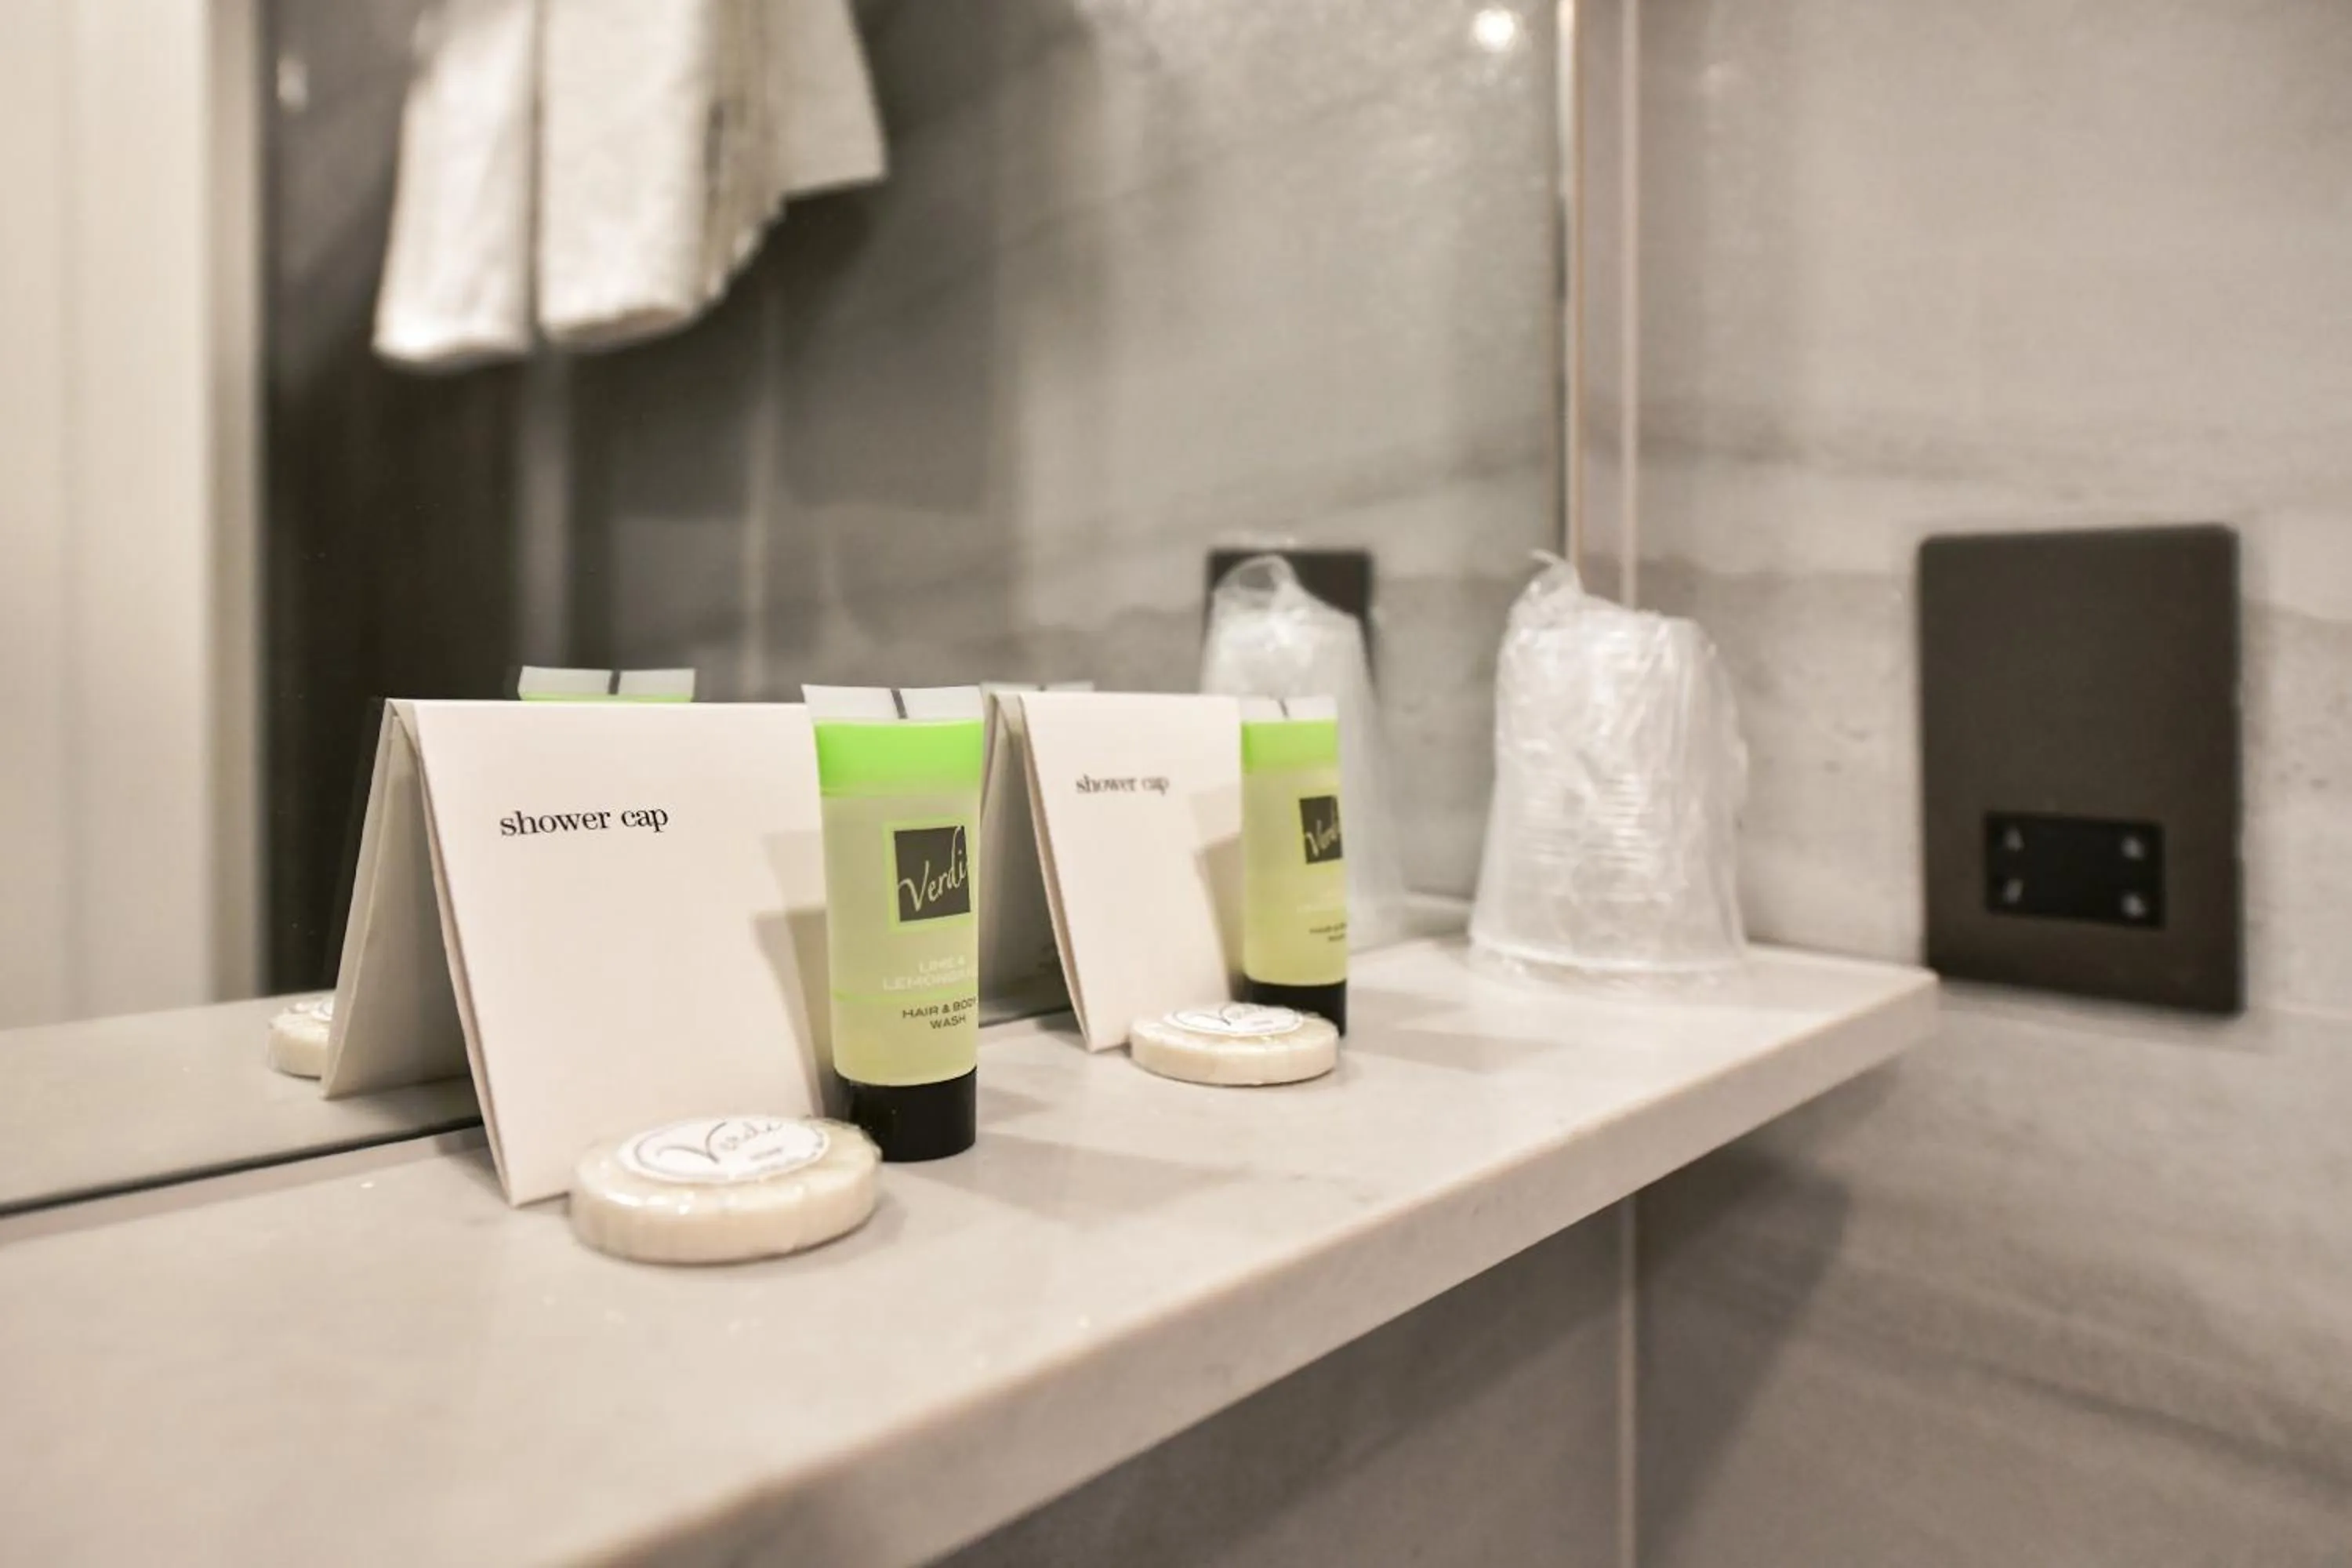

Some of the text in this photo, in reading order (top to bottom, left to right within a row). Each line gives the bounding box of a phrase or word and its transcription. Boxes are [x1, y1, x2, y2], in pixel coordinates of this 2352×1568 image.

[499, 808, 669, 836] shower cap
[898, 825, 969, 912] Verdi
[902, 1005, 939, 1019] HAIR
[942, 1003, 951, 1014] &
[930, 1014, 966, 1029] WASH
